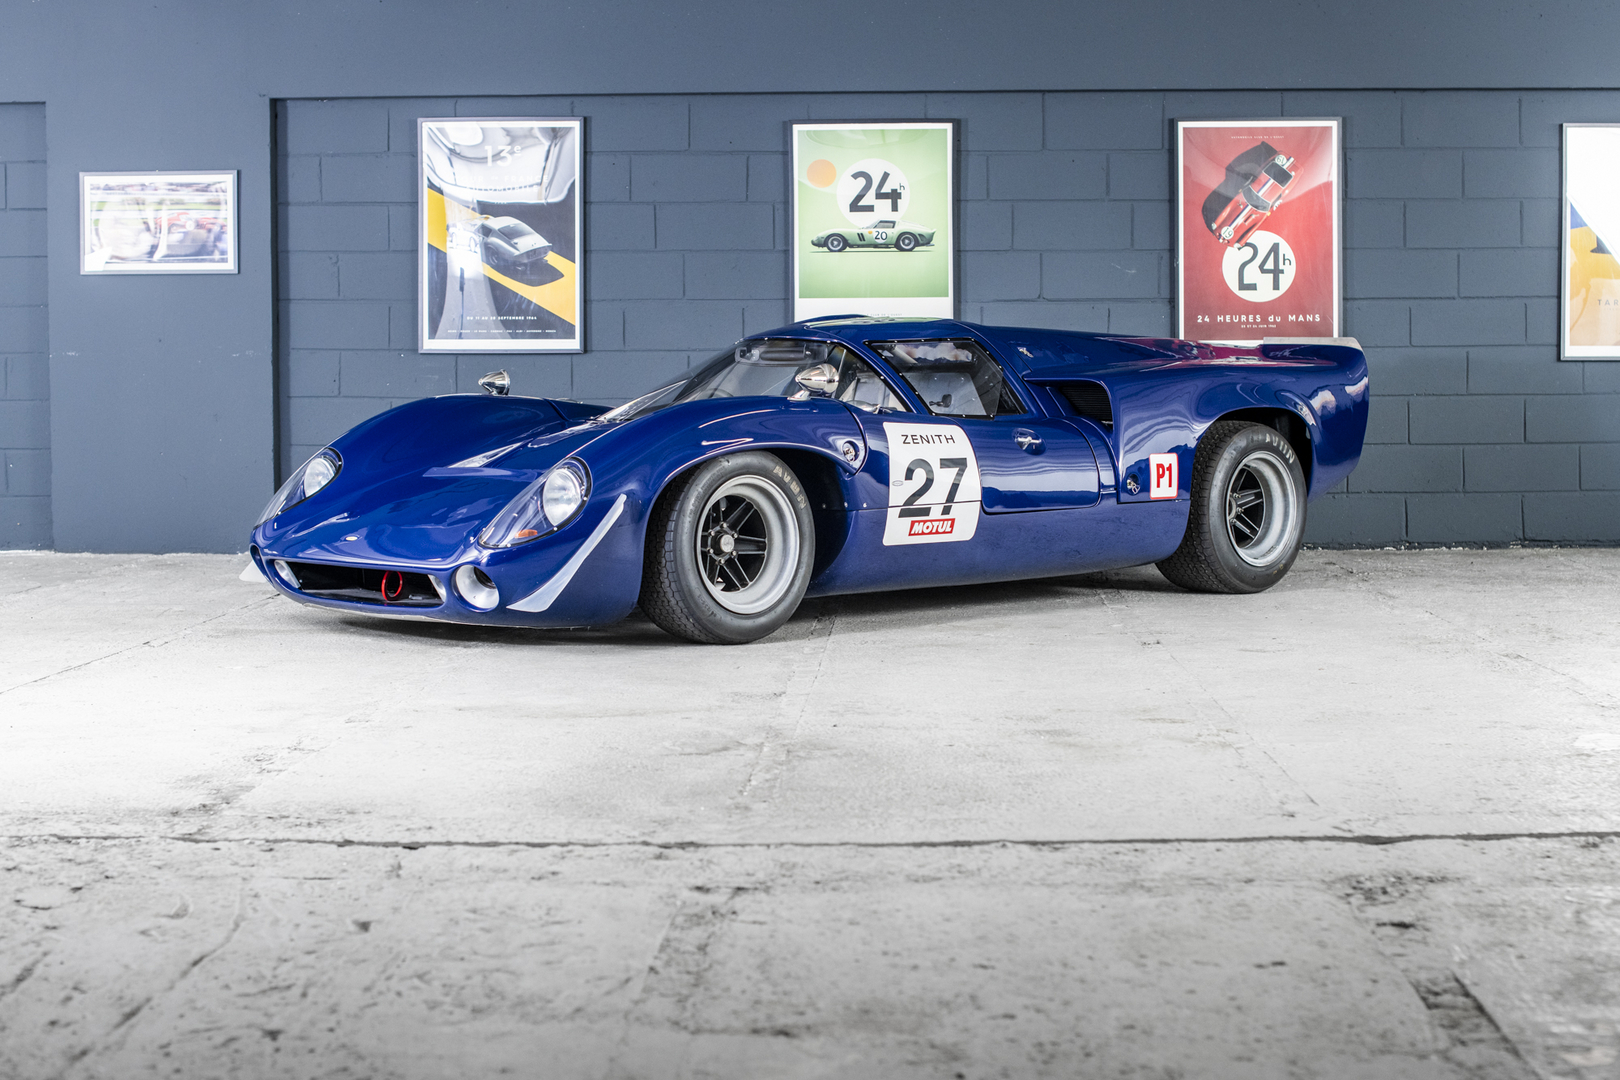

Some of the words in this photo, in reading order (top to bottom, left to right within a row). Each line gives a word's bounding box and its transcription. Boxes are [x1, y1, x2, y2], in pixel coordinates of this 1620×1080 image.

[504, 175, 549, 183] FRANCE
[849, 170, 905, 213] 24h
[875, 230, 888, 241] 20
[1237, 241, 1292, 291] 24h
[1196, 315, 1210, 323] 24
[1217, 314, 1261, 323] HEURES
[1268, 314, 1281, 322] du
[1288, 314, 1321, 322] MANS
[901, 434, 956, 445] ZENITH
[1155, 462, 1173, 489] P1
[898, 457, 968, 519] 27
[910, 520, 952, 534] MOTUL
